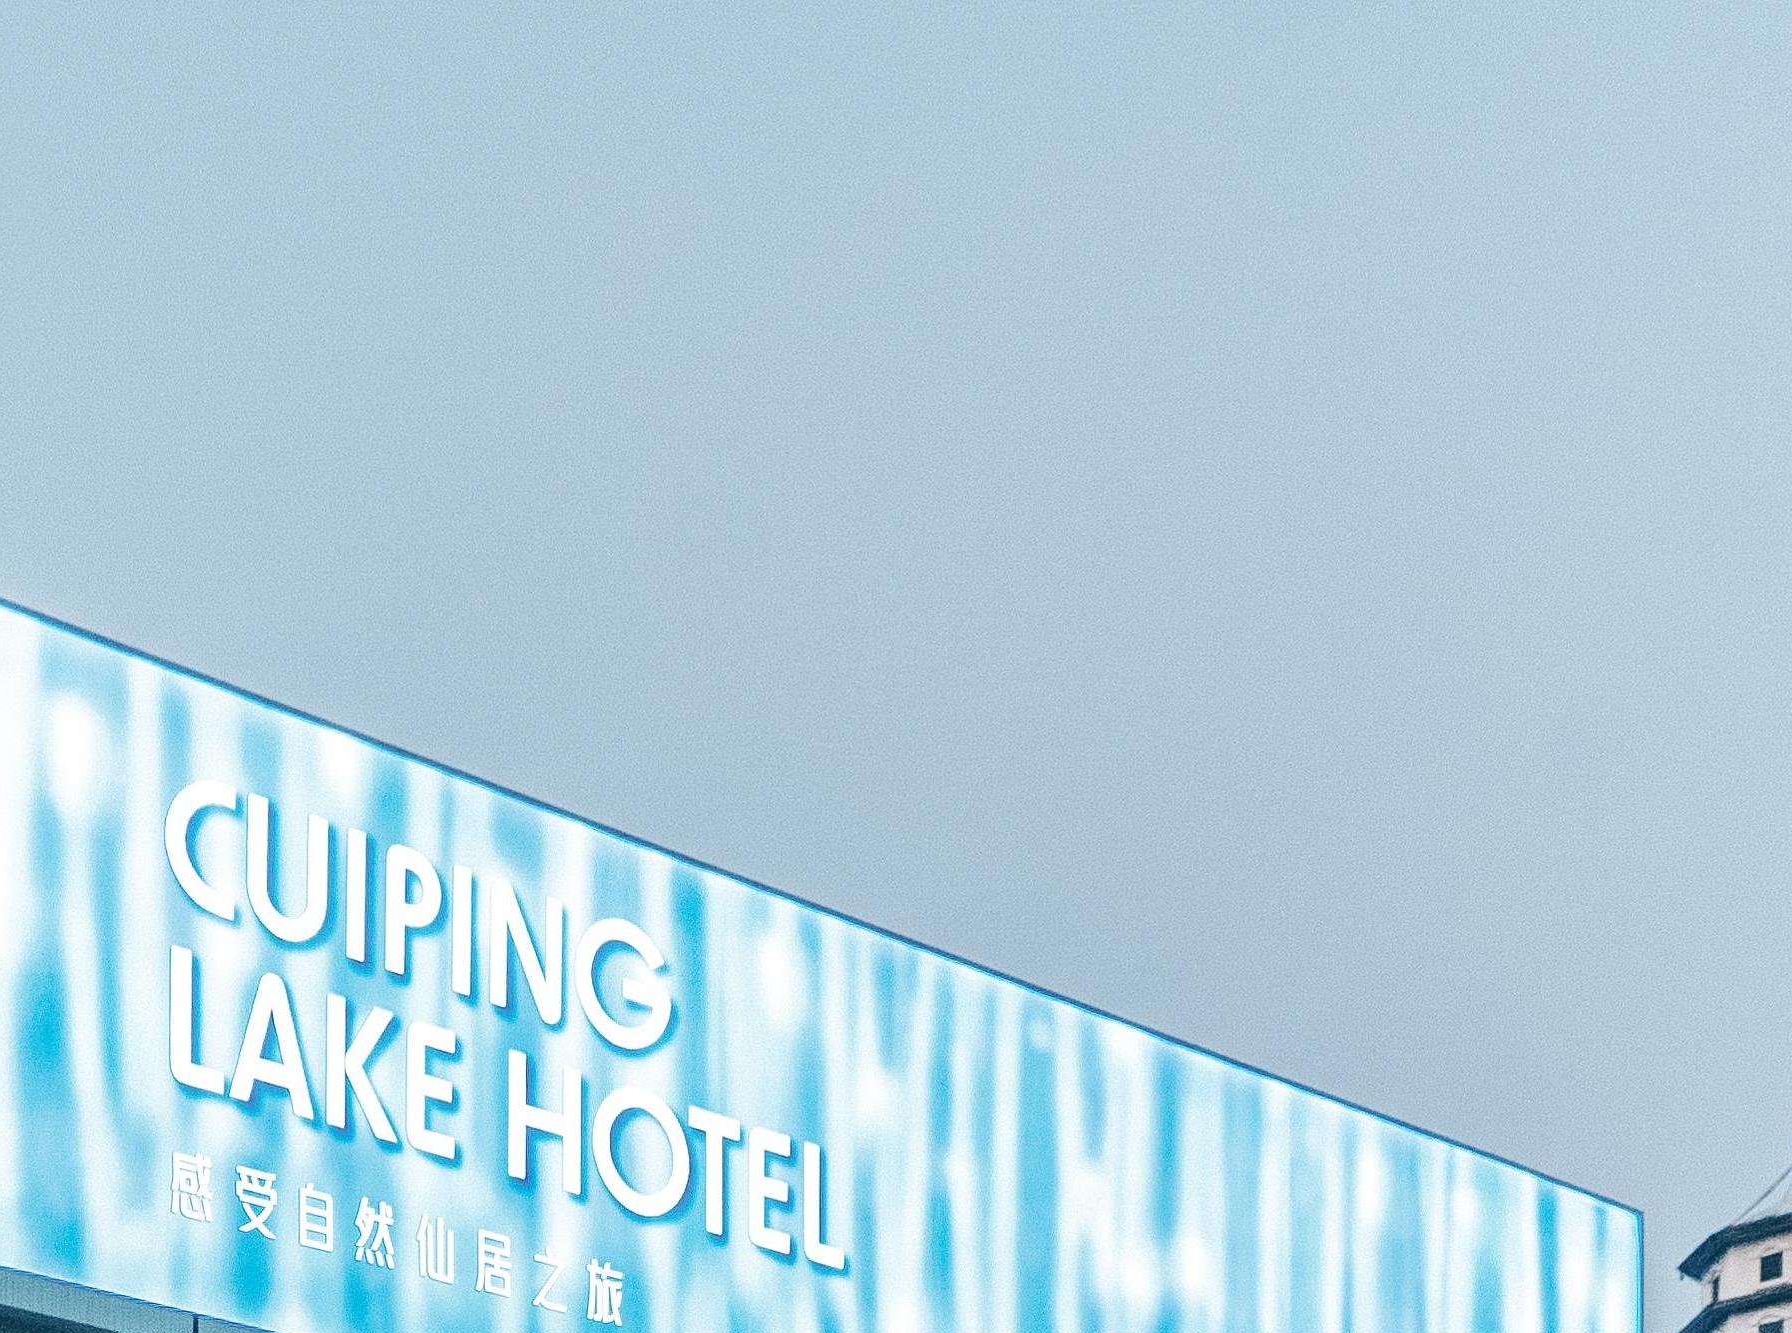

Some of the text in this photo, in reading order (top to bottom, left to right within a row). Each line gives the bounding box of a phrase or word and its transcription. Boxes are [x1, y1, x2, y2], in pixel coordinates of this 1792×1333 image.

[164, 780, 672, 1050] CUIPING
[169, 944, 846, 1271] LAKE HOTEL
[170, 1150, 624, 1327] 感受自然仙居之旅
